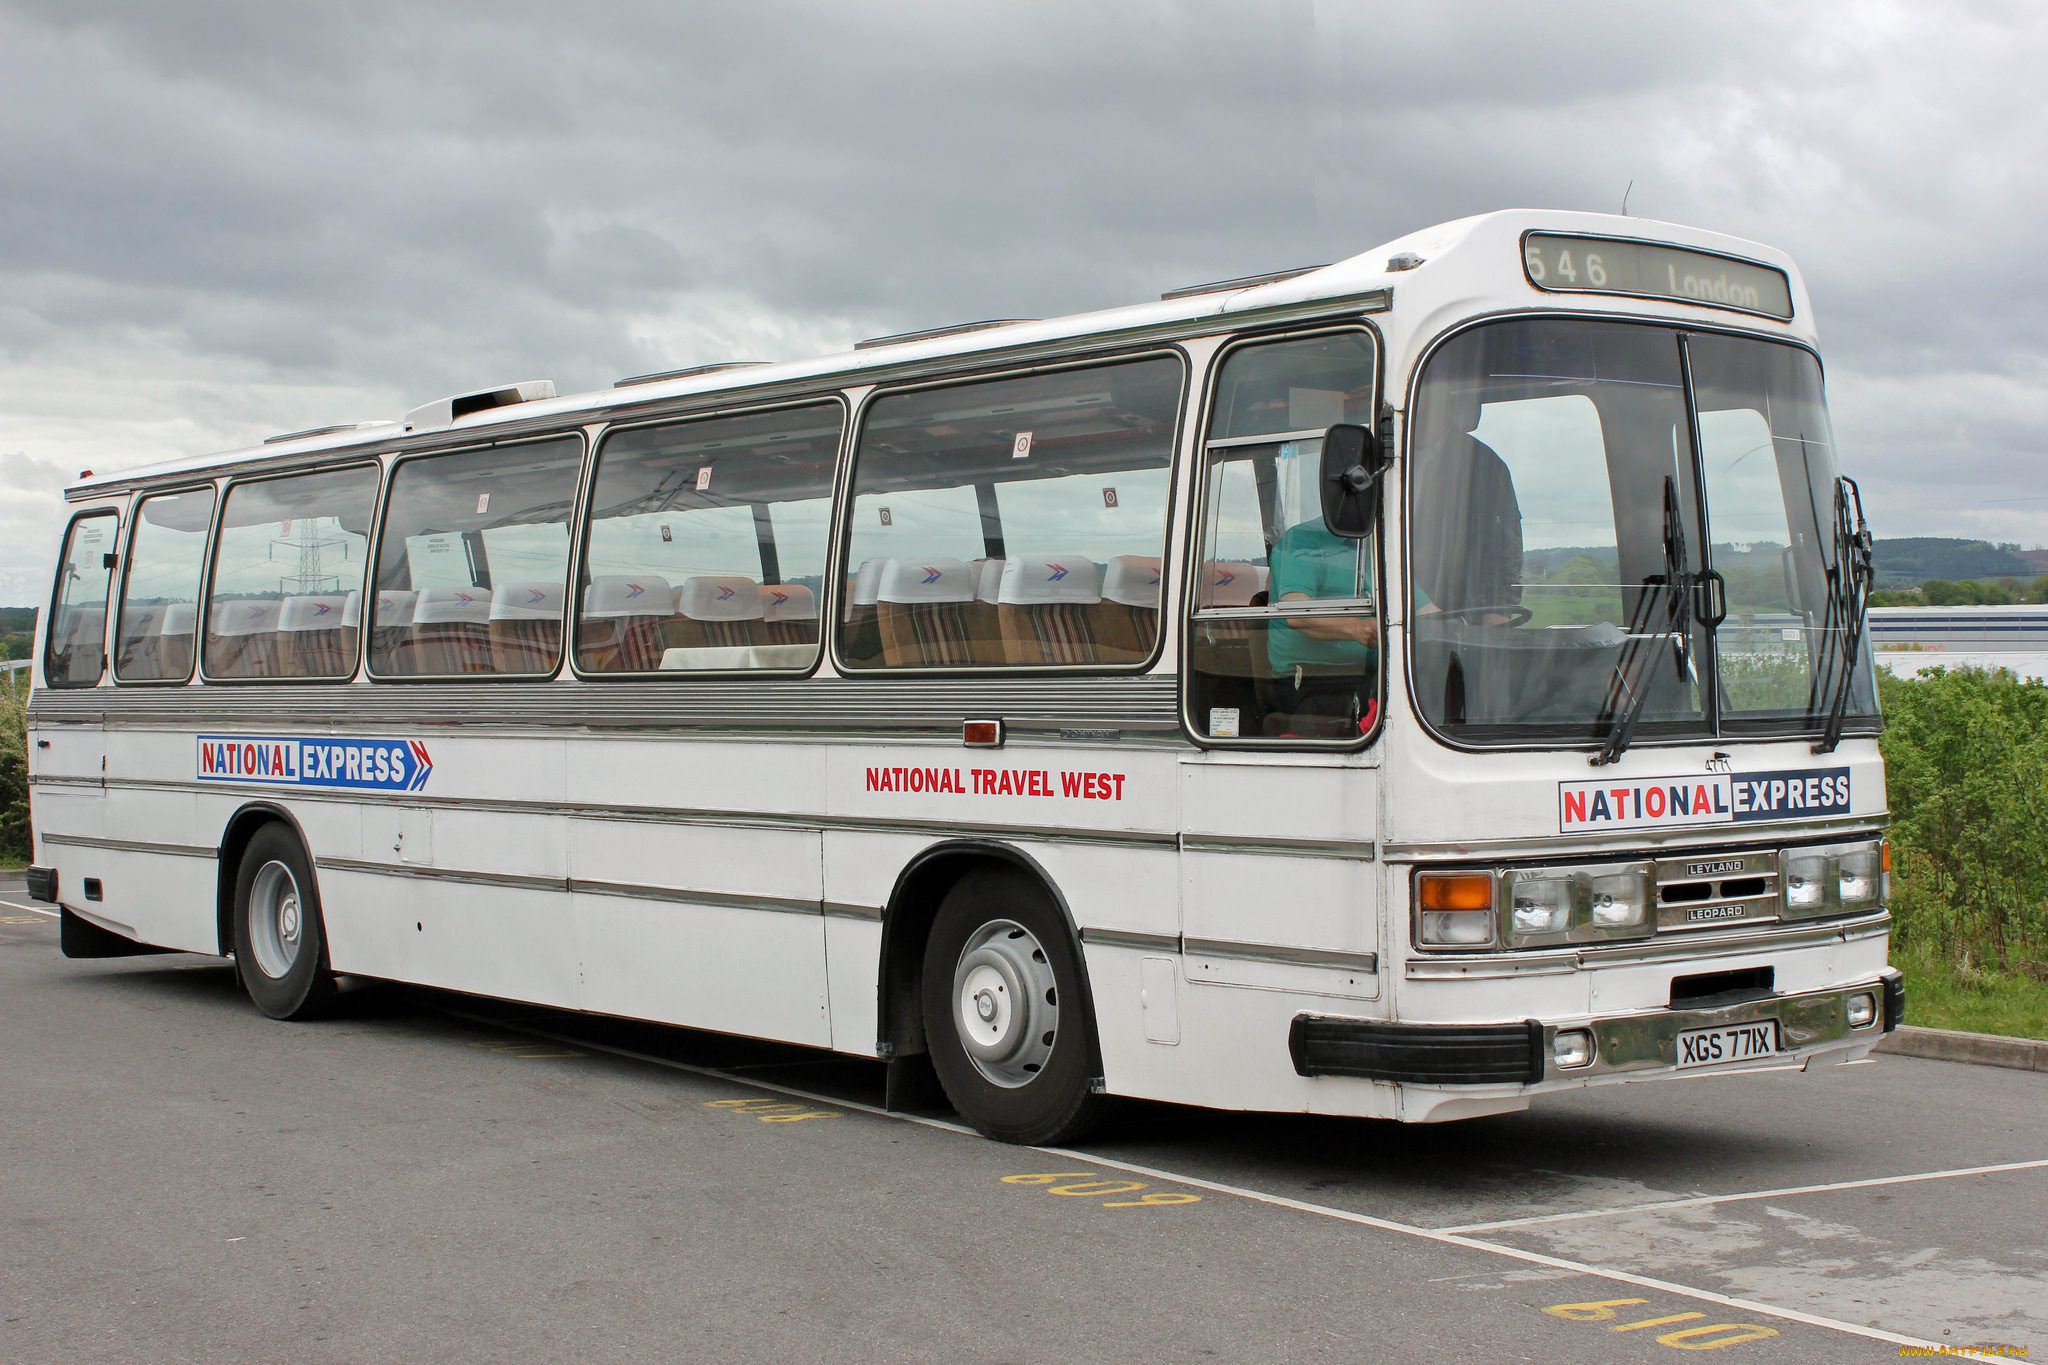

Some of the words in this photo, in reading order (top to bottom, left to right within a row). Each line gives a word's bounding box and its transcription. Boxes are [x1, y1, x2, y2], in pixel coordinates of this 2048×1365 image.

[1667, 263, 1759, 309] London
[202, 742, 296, 777] NATIONAL
[302, 744, 406, 783] EXPRESS
[866, 767, 966, 794] NATIONAL
[970, 768, 1054, 797] TRAVEL
[1061, 771, 1126, 801] WEST
[1563, 783, 1730, 823] NATIONAL
[1732, 775, 1850, 814] EXPRESS
[1689, 861, 1742, 874] LEYLAND
[1689, 906, 1743, 920] LEOPARD
[1682, 1033, 1723, 1064] XGS
[1726, 1026, 1770, 1058] 771X
